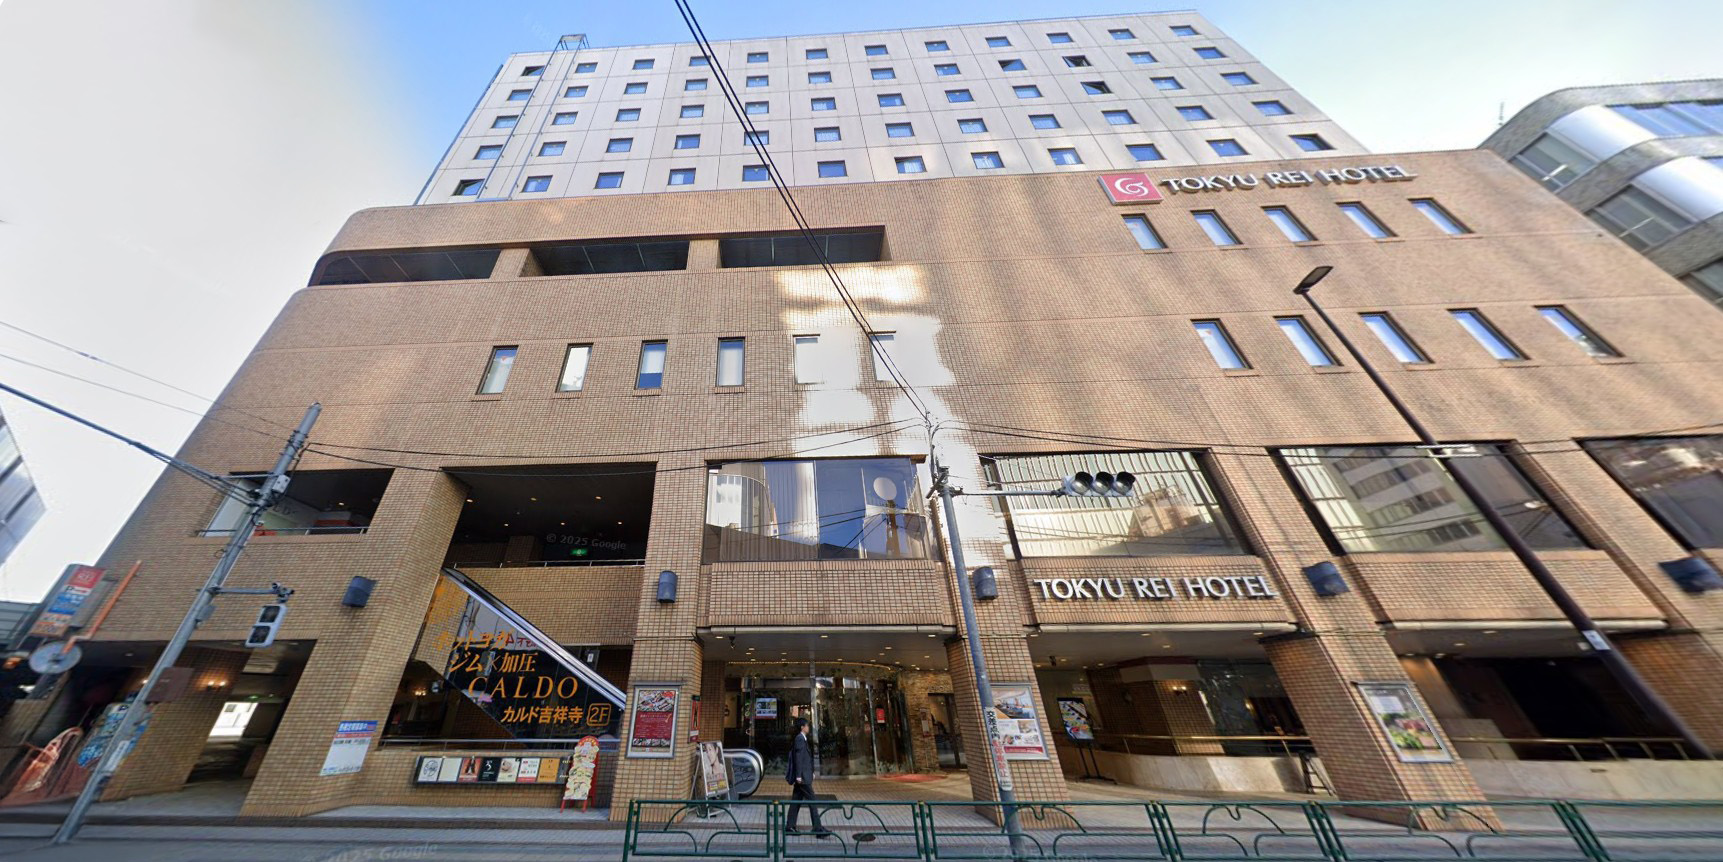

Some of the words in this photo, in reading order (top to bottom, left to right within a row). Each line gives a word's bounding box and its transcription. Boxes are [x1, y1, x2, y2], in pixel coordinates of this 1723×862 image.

[1160, 173, 1259, 194] TOKYU
[1264, 170, 1314, 188] REI
[1315, 164, 1418, 185] HOTEL
[1033, 577, 1125, 599] TOKYU
[1133, 577, 1176, 598] REI
[1184, 575, 1278, 597] HOTEL
[468, 676, 578, 699] CALDO
[501, 705, 582, 724] カルド吉祥寺
[589, 707, 609, 722] 2F
